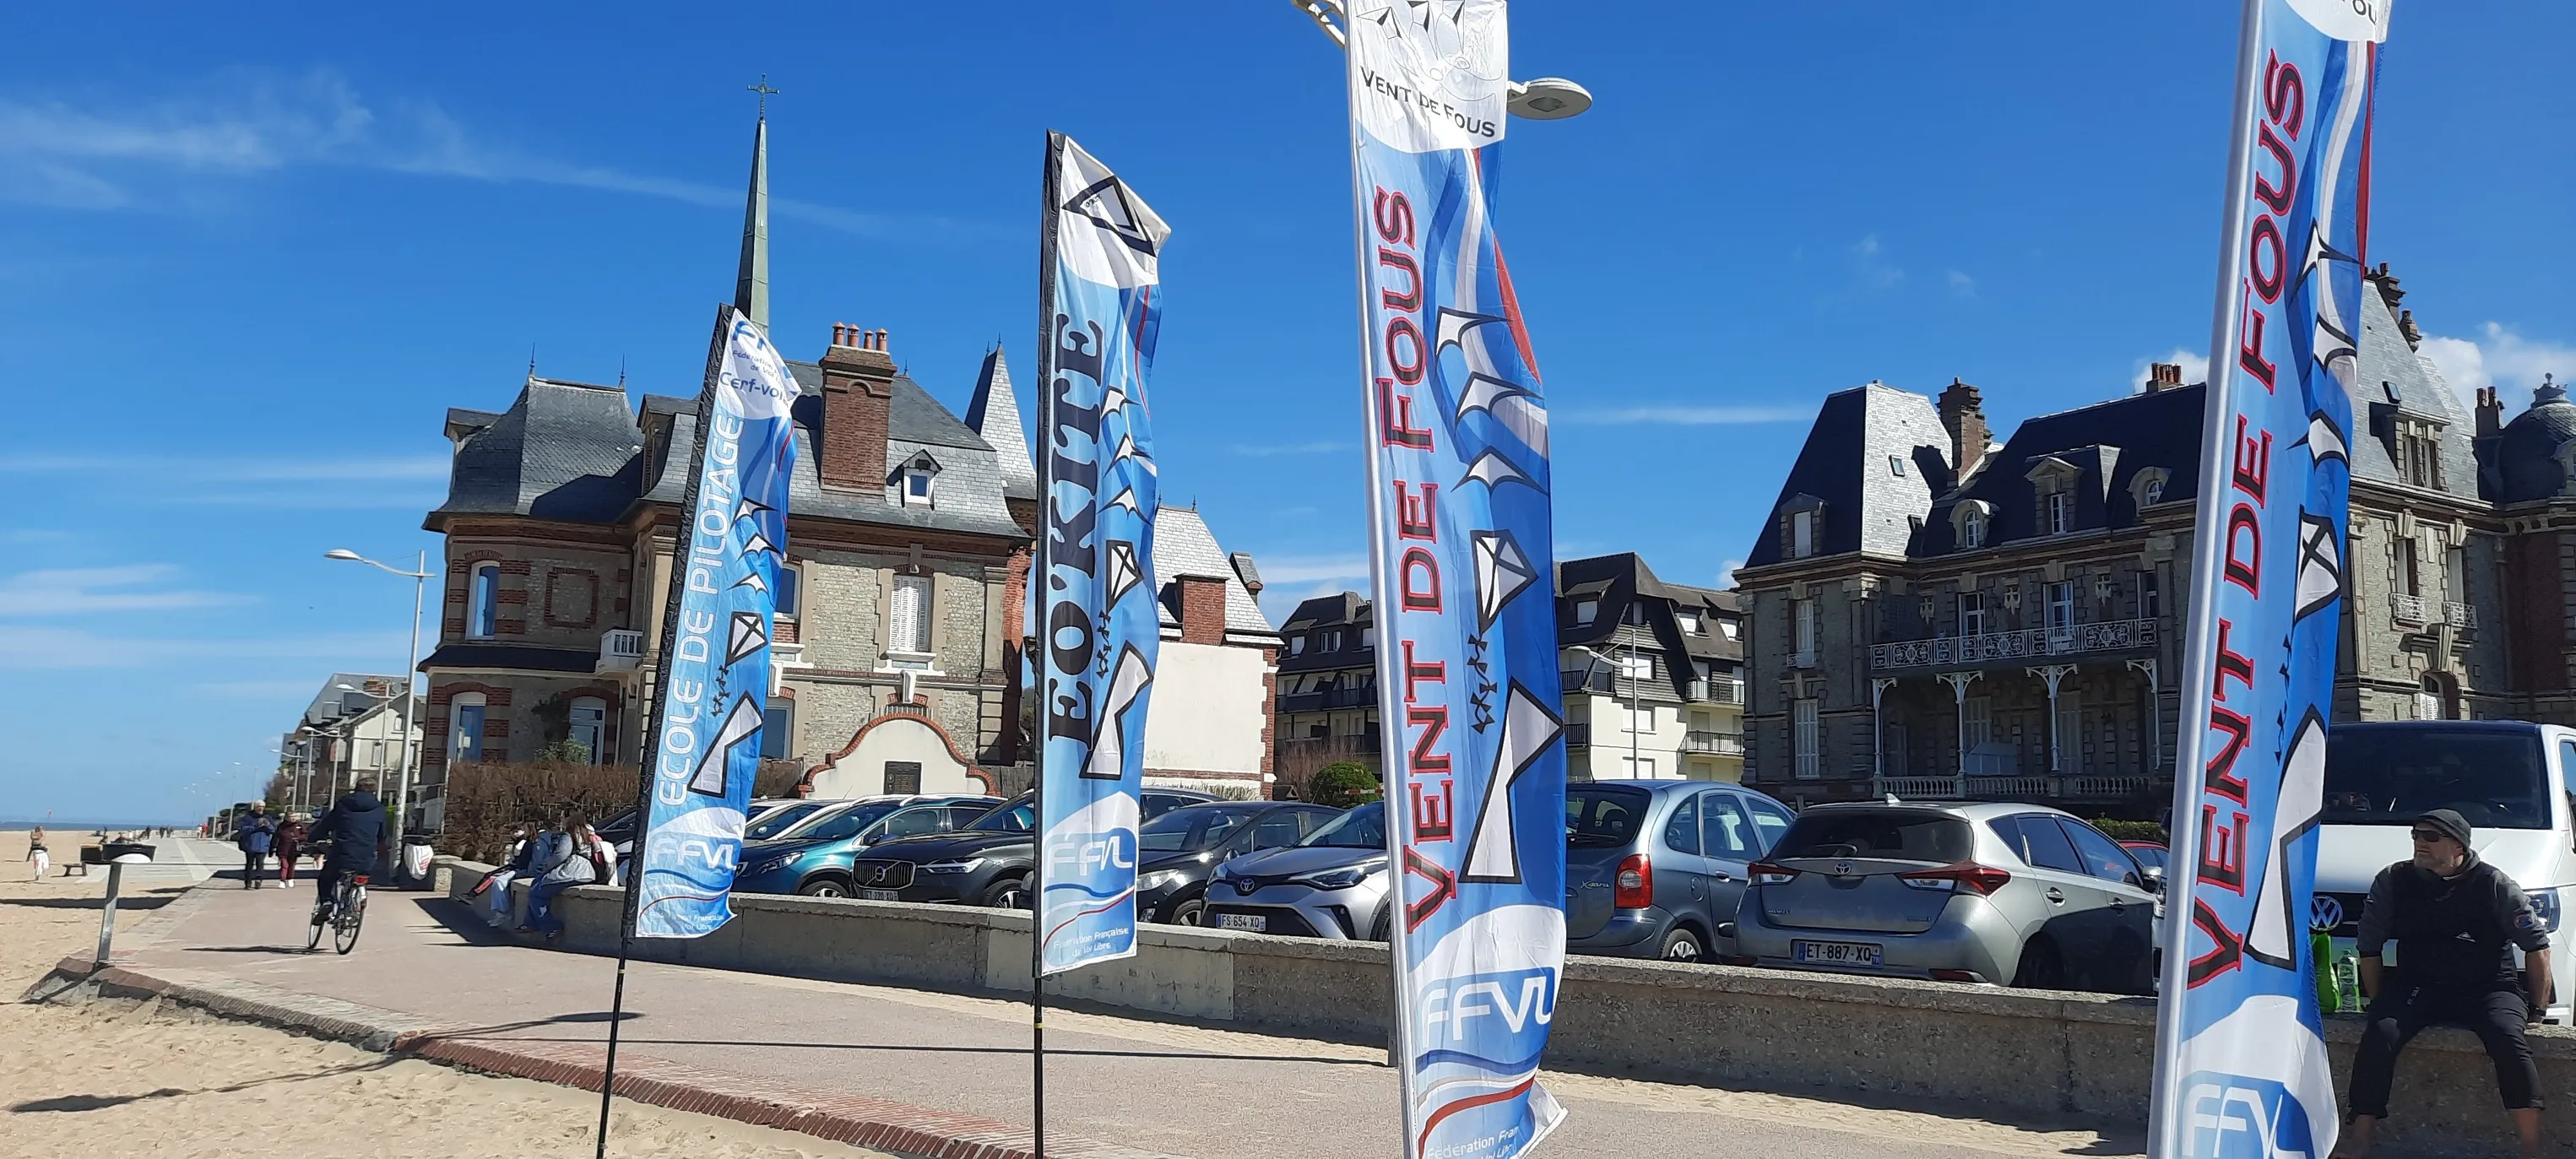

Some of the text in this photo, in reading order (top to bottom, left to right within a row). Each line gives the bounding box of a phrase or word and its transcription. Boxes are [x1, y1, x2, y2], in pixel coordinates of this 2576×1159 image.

[1360, 66, 1496, 138] VENT DE FOUS
[1048, 313, 1103, 750] EO'KITE
[2187, 47, 2304, 989] VENT DE FOUS
[1374, 185, 1456, 934] VENT DE FOUS
[658, 413, 745, 806] ECOLE DE PILOTAGE
[1094, 927, 1128, 940] Française
[1094, 942, 1111, 951] Libre
[1422, 976, 1552, 1048] FFVL
[1427, 1136, 1494, 1159] Fédération
